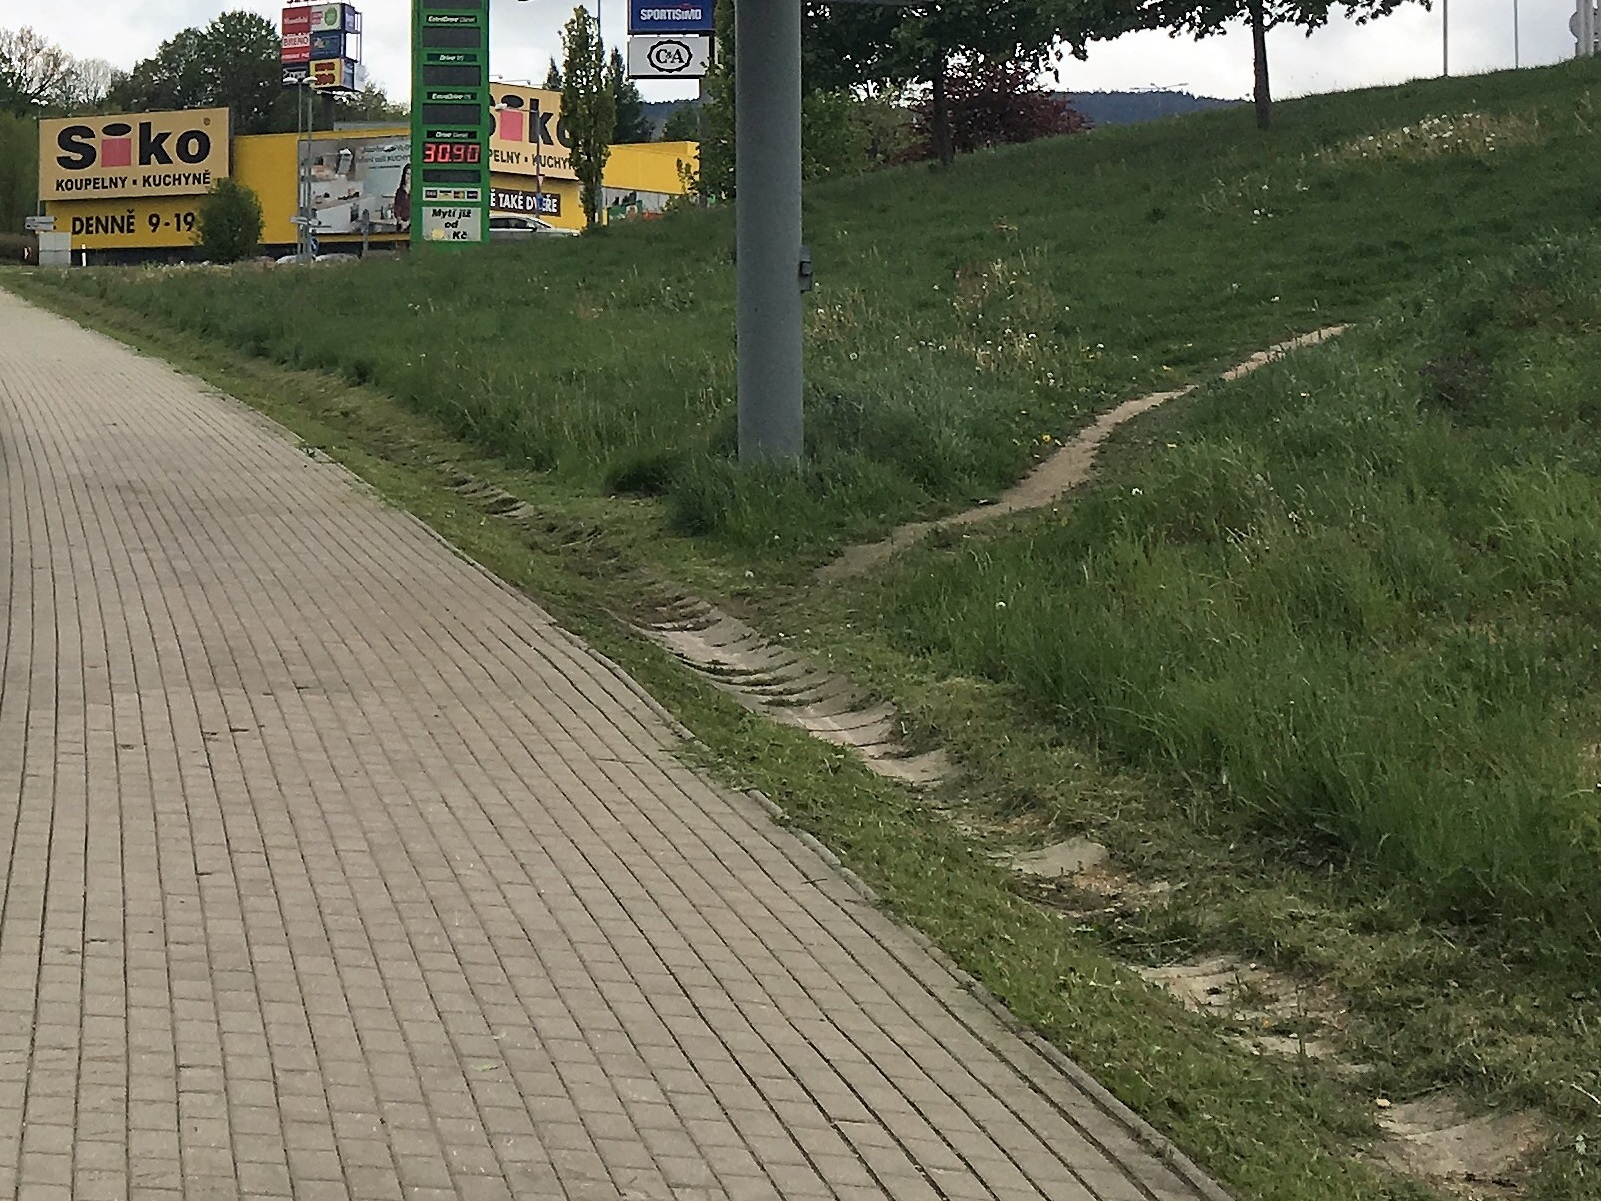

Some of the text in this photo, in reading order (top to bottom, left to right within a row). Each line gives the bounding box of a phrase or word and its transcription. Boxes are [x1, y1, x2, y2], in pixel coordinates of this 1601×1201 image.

[655, 48, 685, 64] C&A
[423, 143, 479, 163] 30.90
[55, 169, 211, 192] KOUPELNY KUCHYNĚ
[498, 191, 524, 210] TAKÉ
[71, 209, 135, 235] DENNĚ
[444, 220, 459, 229] od
[452, 231, 468, 240] Kč
